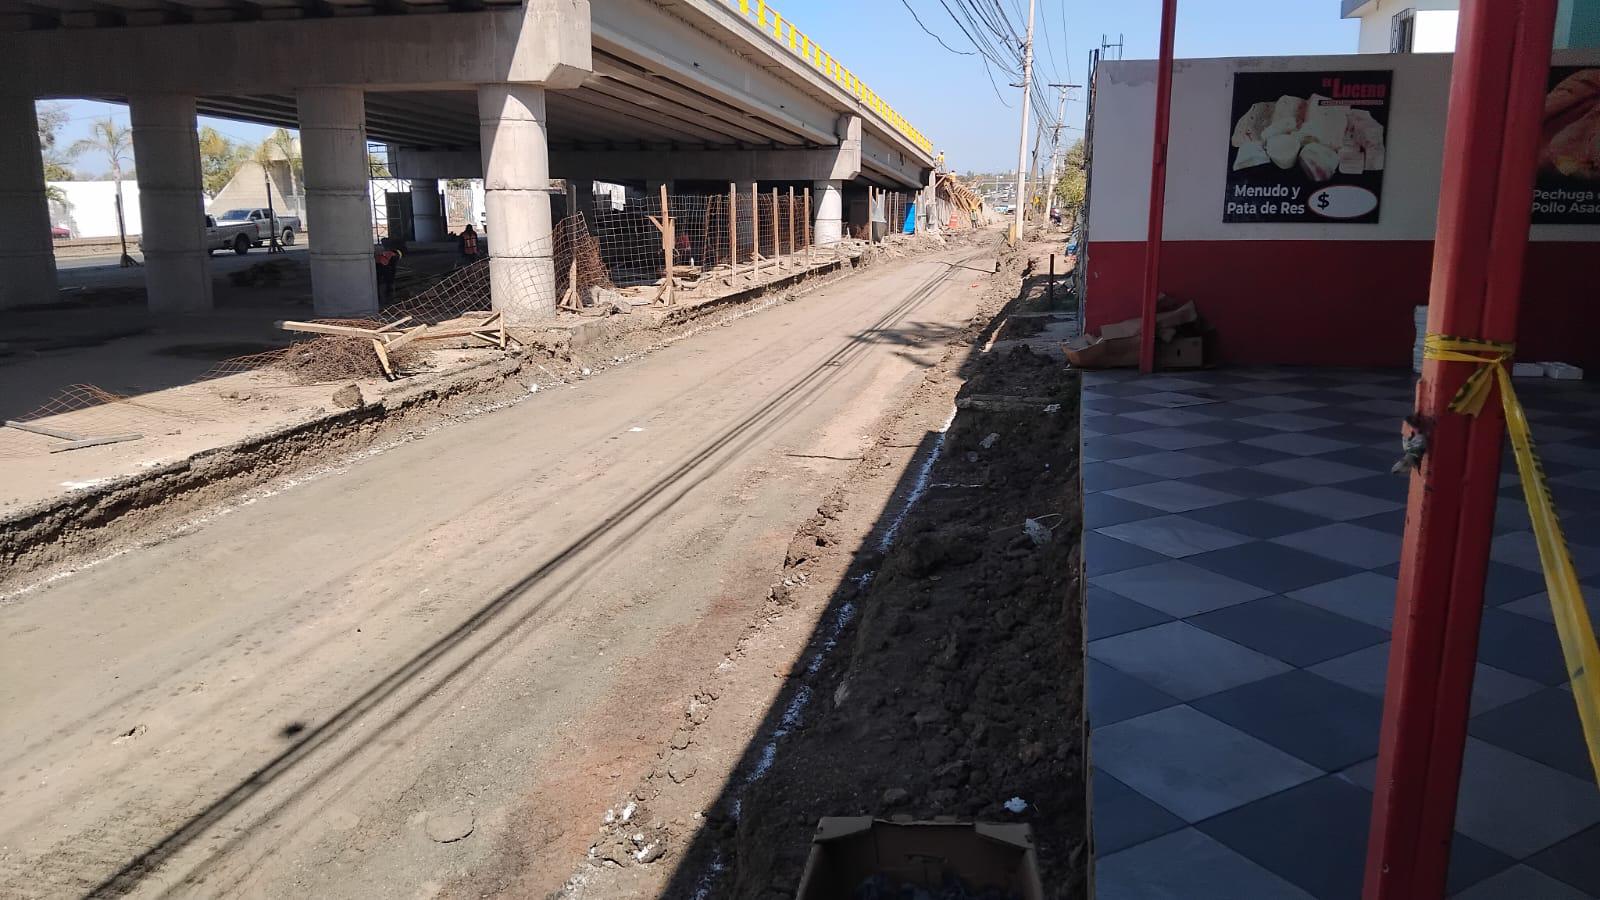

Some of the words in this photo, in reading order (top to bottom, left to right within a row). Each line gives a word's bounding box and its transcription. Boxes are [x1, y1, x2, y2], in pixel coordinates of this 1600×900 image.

[1234, 184, 1289, 197] Menudo
[1291, 186, 1301, 200] y
[1532, 188, 1594, 202] Pechuga
[1227, 202, 1257, 214] Pata
[1260, 201, 1278, 214] de
[1280, 202, 1305, 214] Res
[1317, 191, 1330, 210] $
[1531, 201, 1566, 213] Pollo
